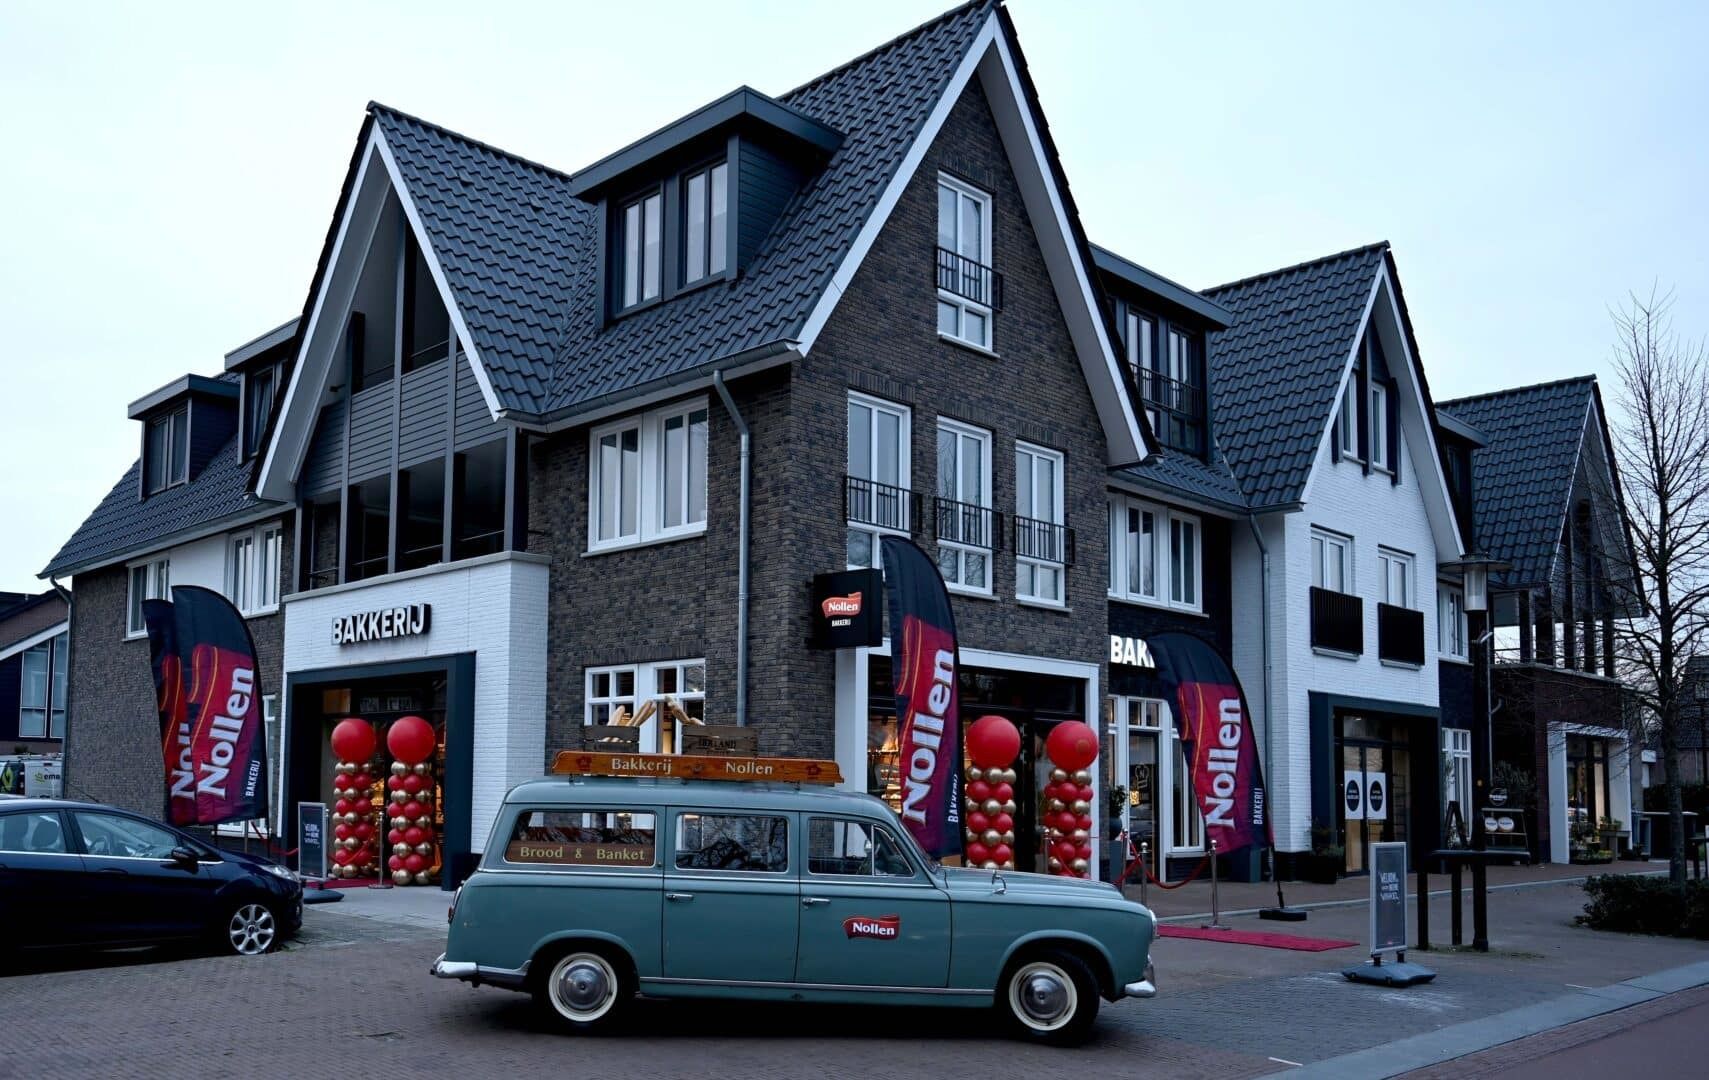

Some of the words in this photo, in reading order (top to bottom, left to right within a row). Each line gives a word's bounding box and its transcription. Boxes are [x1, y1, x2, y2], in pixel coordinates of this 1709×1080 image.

[332, 603, 430, 646] BAKKERIJ
[828, 601, 858, 612] Nollen
[197, 667, 254, 800] Nollen
[902, 649, 954, 828] Nollen
[245, 760, 260, 797] BAKKERIJ
[611, 757, 672, 774] Bakkerij
[726, 761, 773, 775] Nollen
[1205, 698, 1242, 831] Nollen
[1253, 787, 1264, 825] BAKKERIJ
[520, 846, 563, 858] Brood
[575, 848, 582, 859] &
[597, 848, 645, 860] Banket
[852, 922, 895, 936] Nollen
